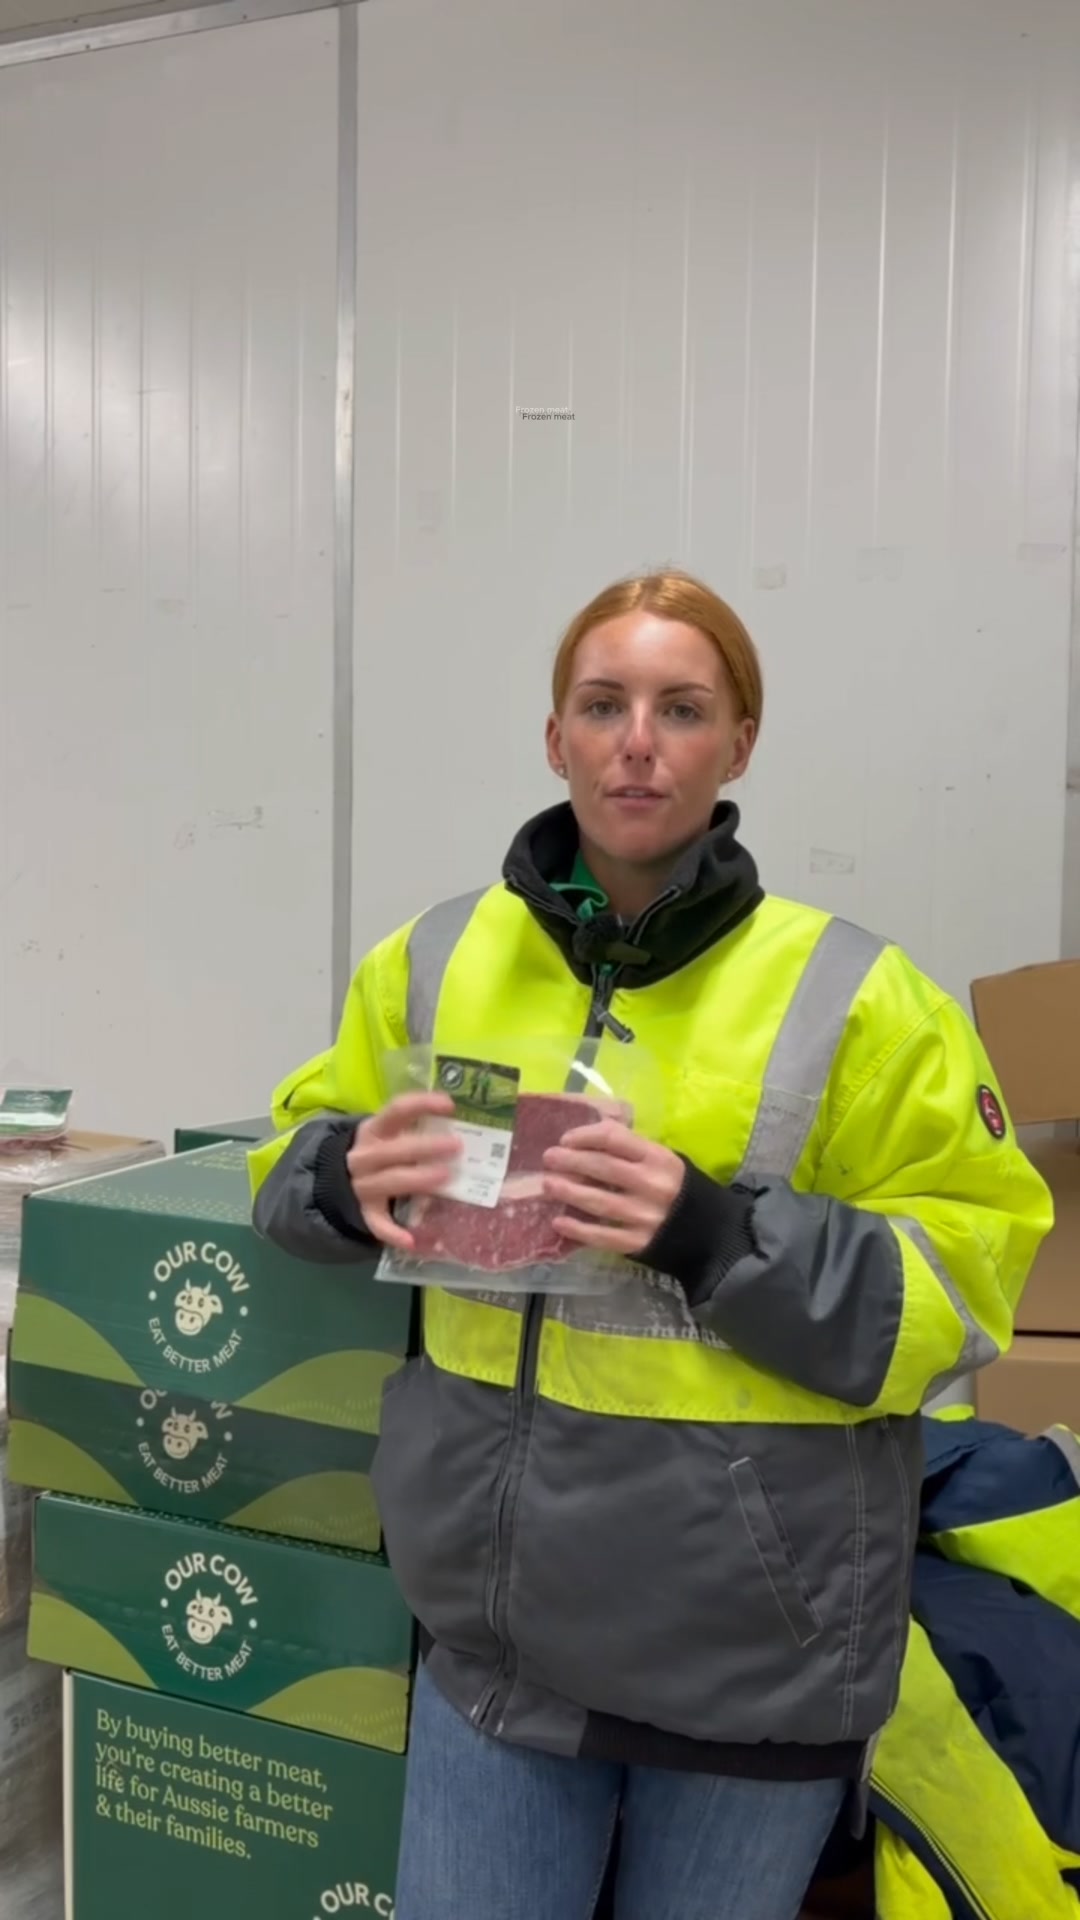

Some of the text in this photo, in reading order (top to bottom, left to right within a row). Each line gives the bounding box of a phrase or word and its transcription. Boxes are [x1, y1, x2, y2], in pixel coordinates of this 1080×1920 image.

[154, 1241, 250, 1293] OUR COW
[148, 1317, 242, 1373] EAT BETTER MEAT
[138, 1441, 229, 1494] EAT BETTER MEAT
[165, 1552, 258, 1606] OUR COW
[161, 1624, 253, 1681] EAT BETTER MEAT
[96, 1708, 122, 1738] By
[126, 1715, 193, 1758] buying
[199, 1734, 262, 1772] better
[267, 1759, 328, 1793] meat,
[95, 1741, 334, 1821] you're creating a better
[96, 1763, 320, 1849] life for Aussie farmers
[95, 1793, 252, 1860] & their families.
[320, 1881, 371, 1914] OUR
